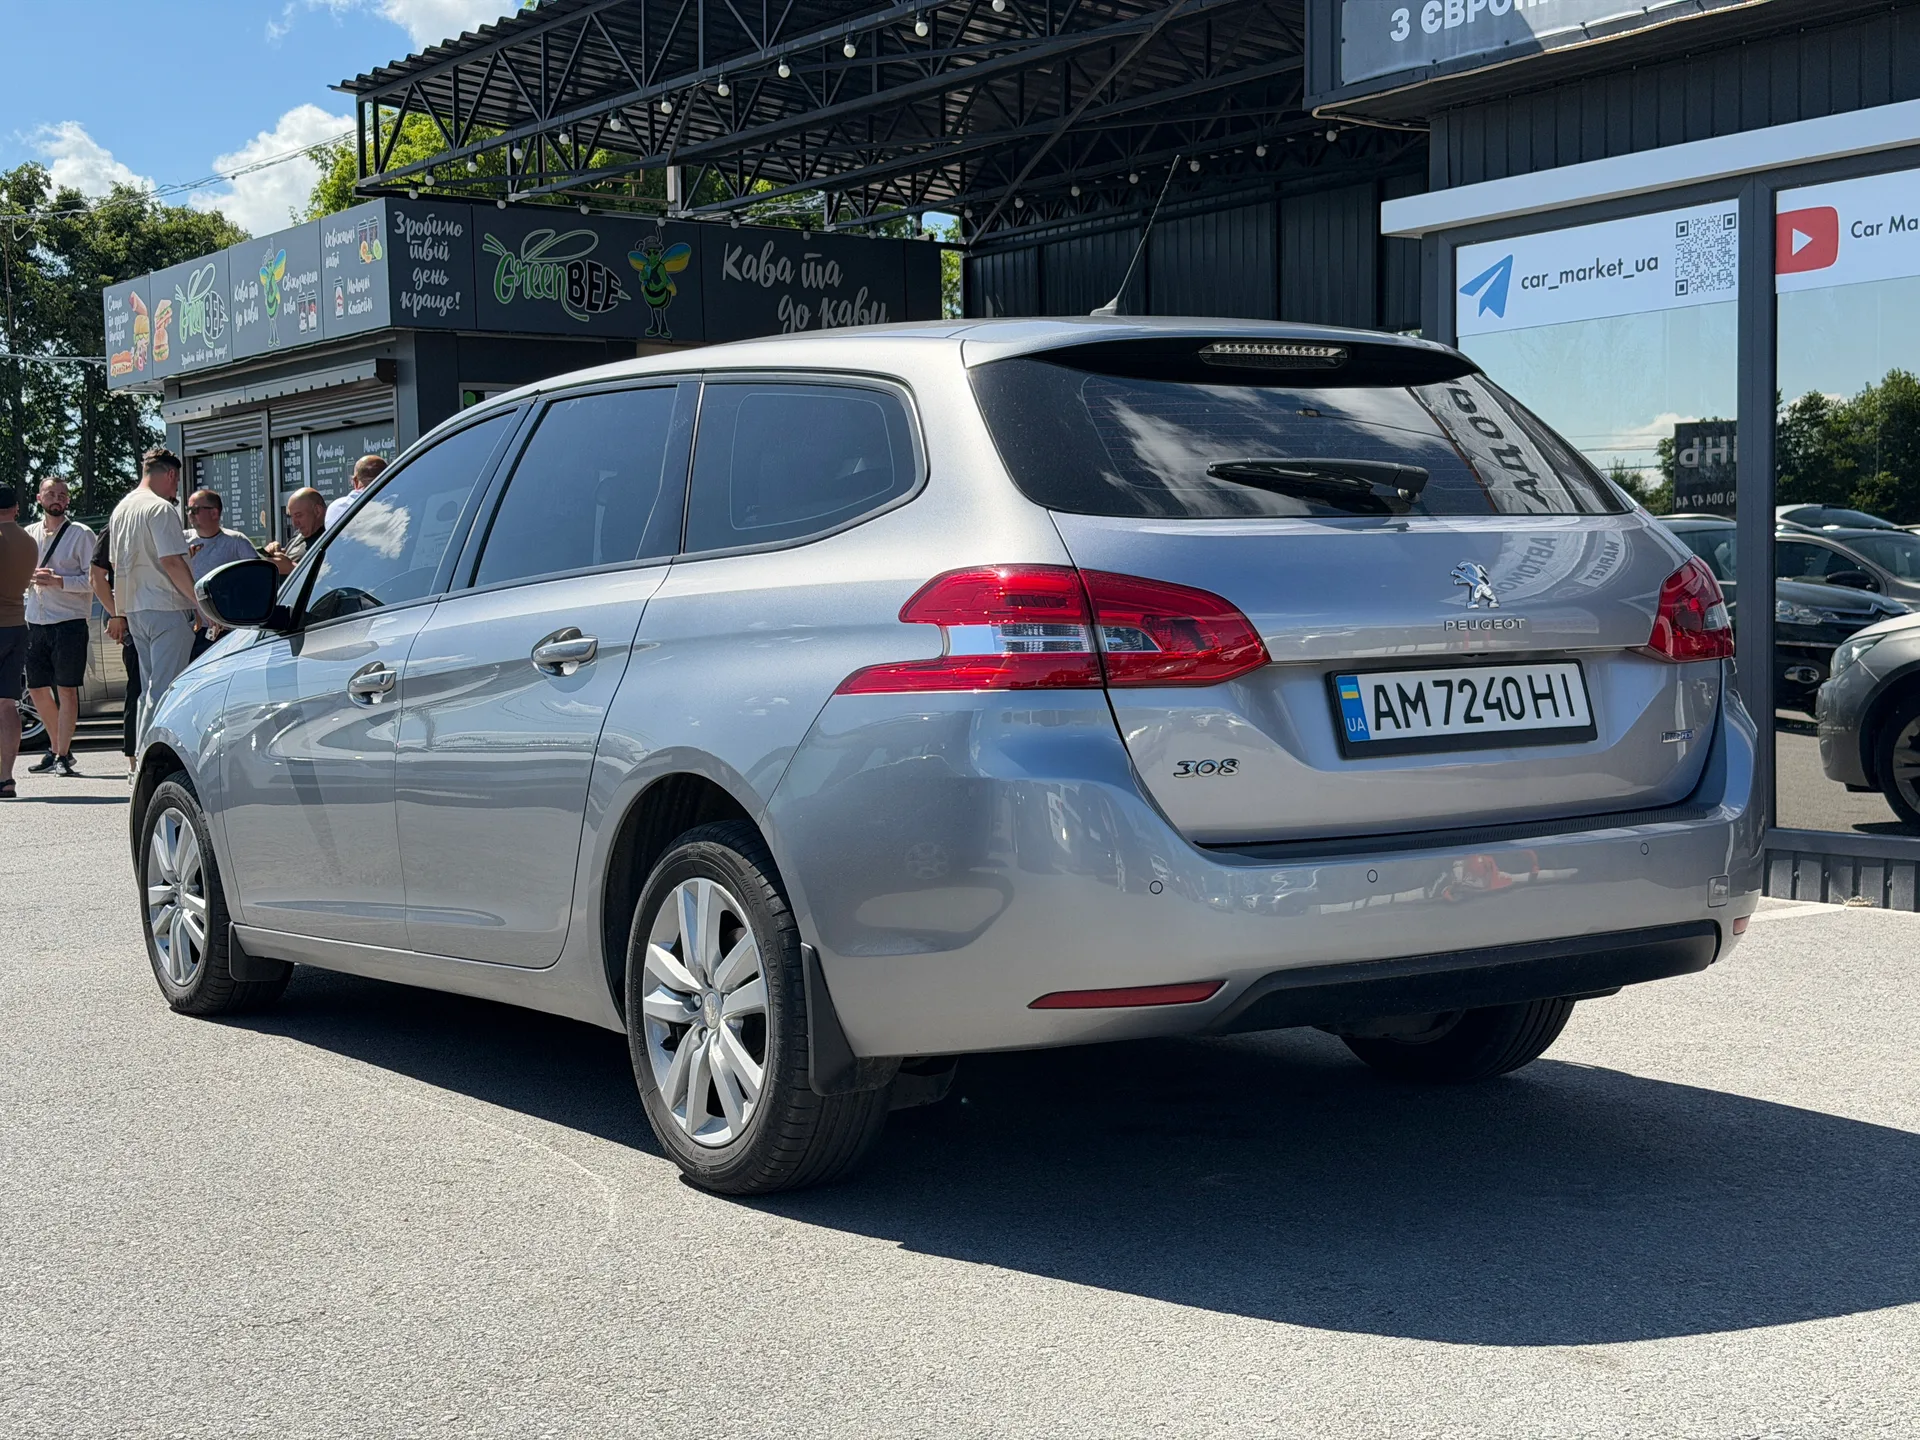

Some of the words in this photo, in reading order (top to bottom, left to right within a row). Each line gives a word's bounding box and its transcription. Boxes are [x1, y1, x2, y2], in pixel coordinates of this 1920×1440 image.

[1420, 0, 1548, 34] ЄВРО
[394, 211, 463, 243] Зробимо
[1850, 220, 1883, 239] Car
[1888, 213, 1919, 234] Ma
[409, 240, 450, 262] твій
[722, 240, 796, 288] Кава
[801, 252, 843, 290] та
[1521, 256, 1659, 291] car_market_ua
[412, 267, 449, 290] день
[400, 291, 461, 318] краще!
[777, 294, 811, 333] до
[818, 286, 889, 328] кави
[1443, 617, 1526, 632] PEUGEOT
[1346, 717, 1367, 733] UA
[1173, 758, 1240, 778] 308
